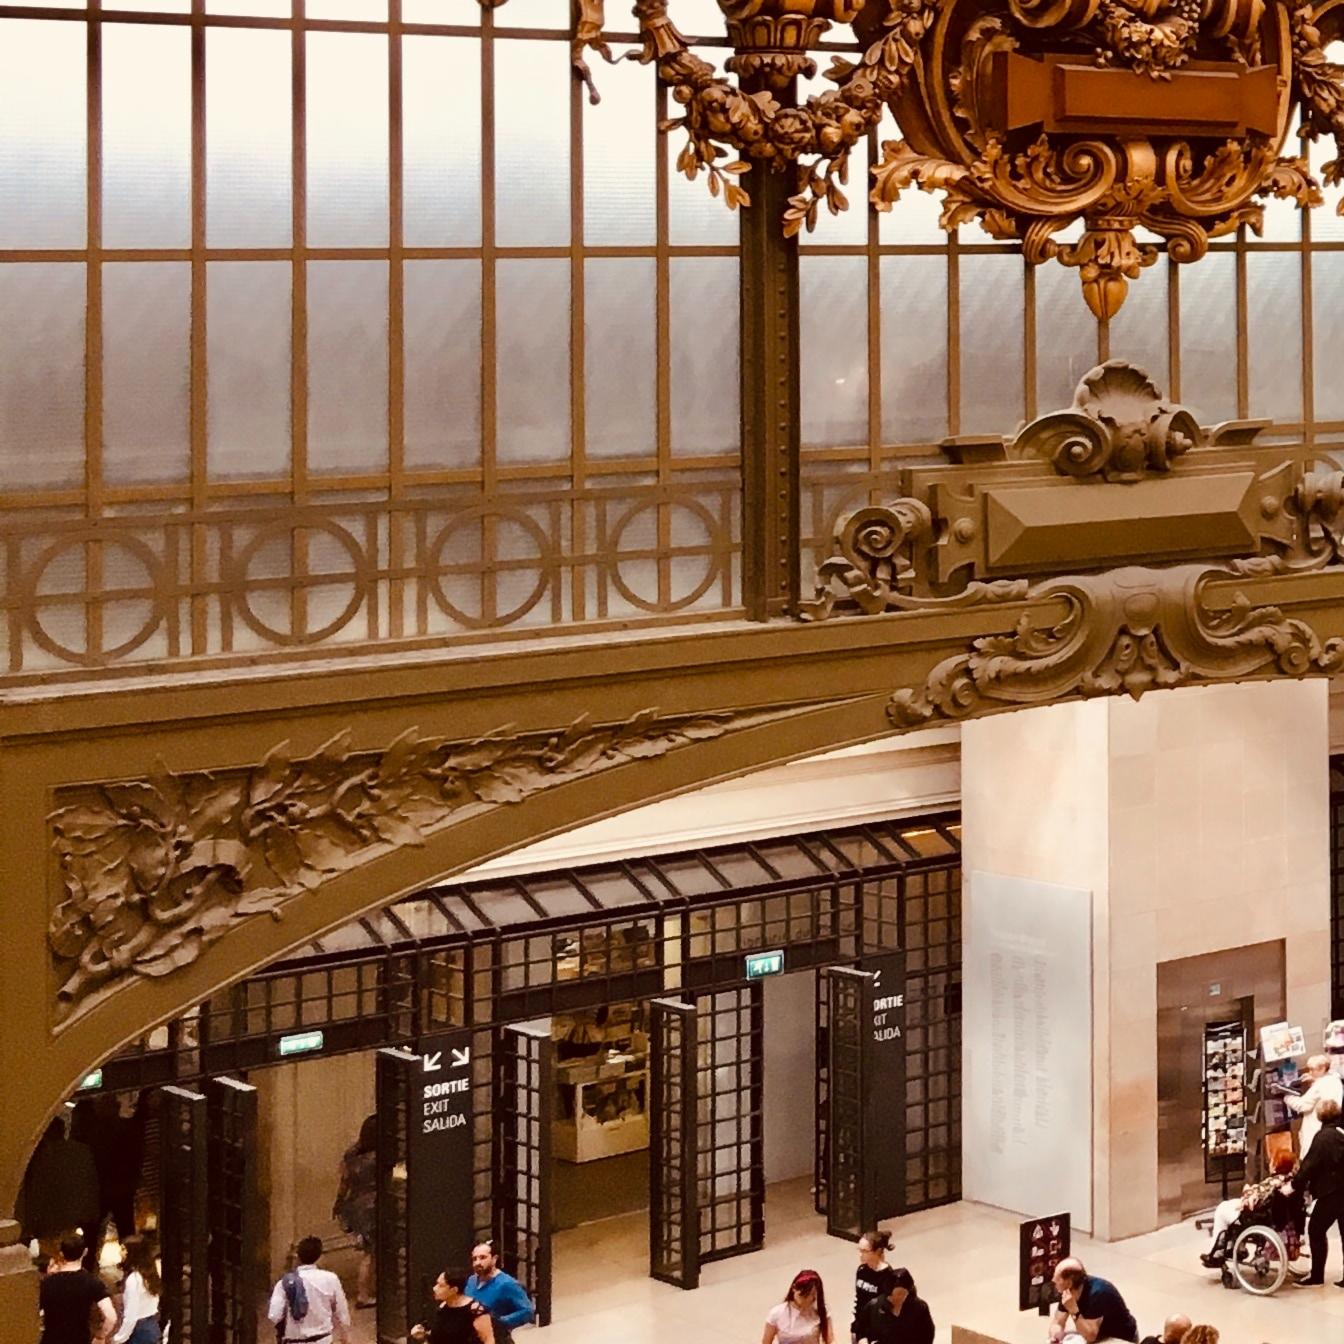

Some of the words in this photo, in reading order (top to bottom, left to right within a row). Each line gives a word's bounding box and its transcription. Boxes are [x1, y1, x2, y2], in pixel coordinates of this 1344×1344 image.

[873, 994, 903, 1012] ORTIE
[873, 1025, 901, 1042] ALIDA
[423, 1077, 470, 1099] SORTIE
[423, 1098, 450, 1116] EXIT
[422, 1113, 467, 1134] SALIDA
